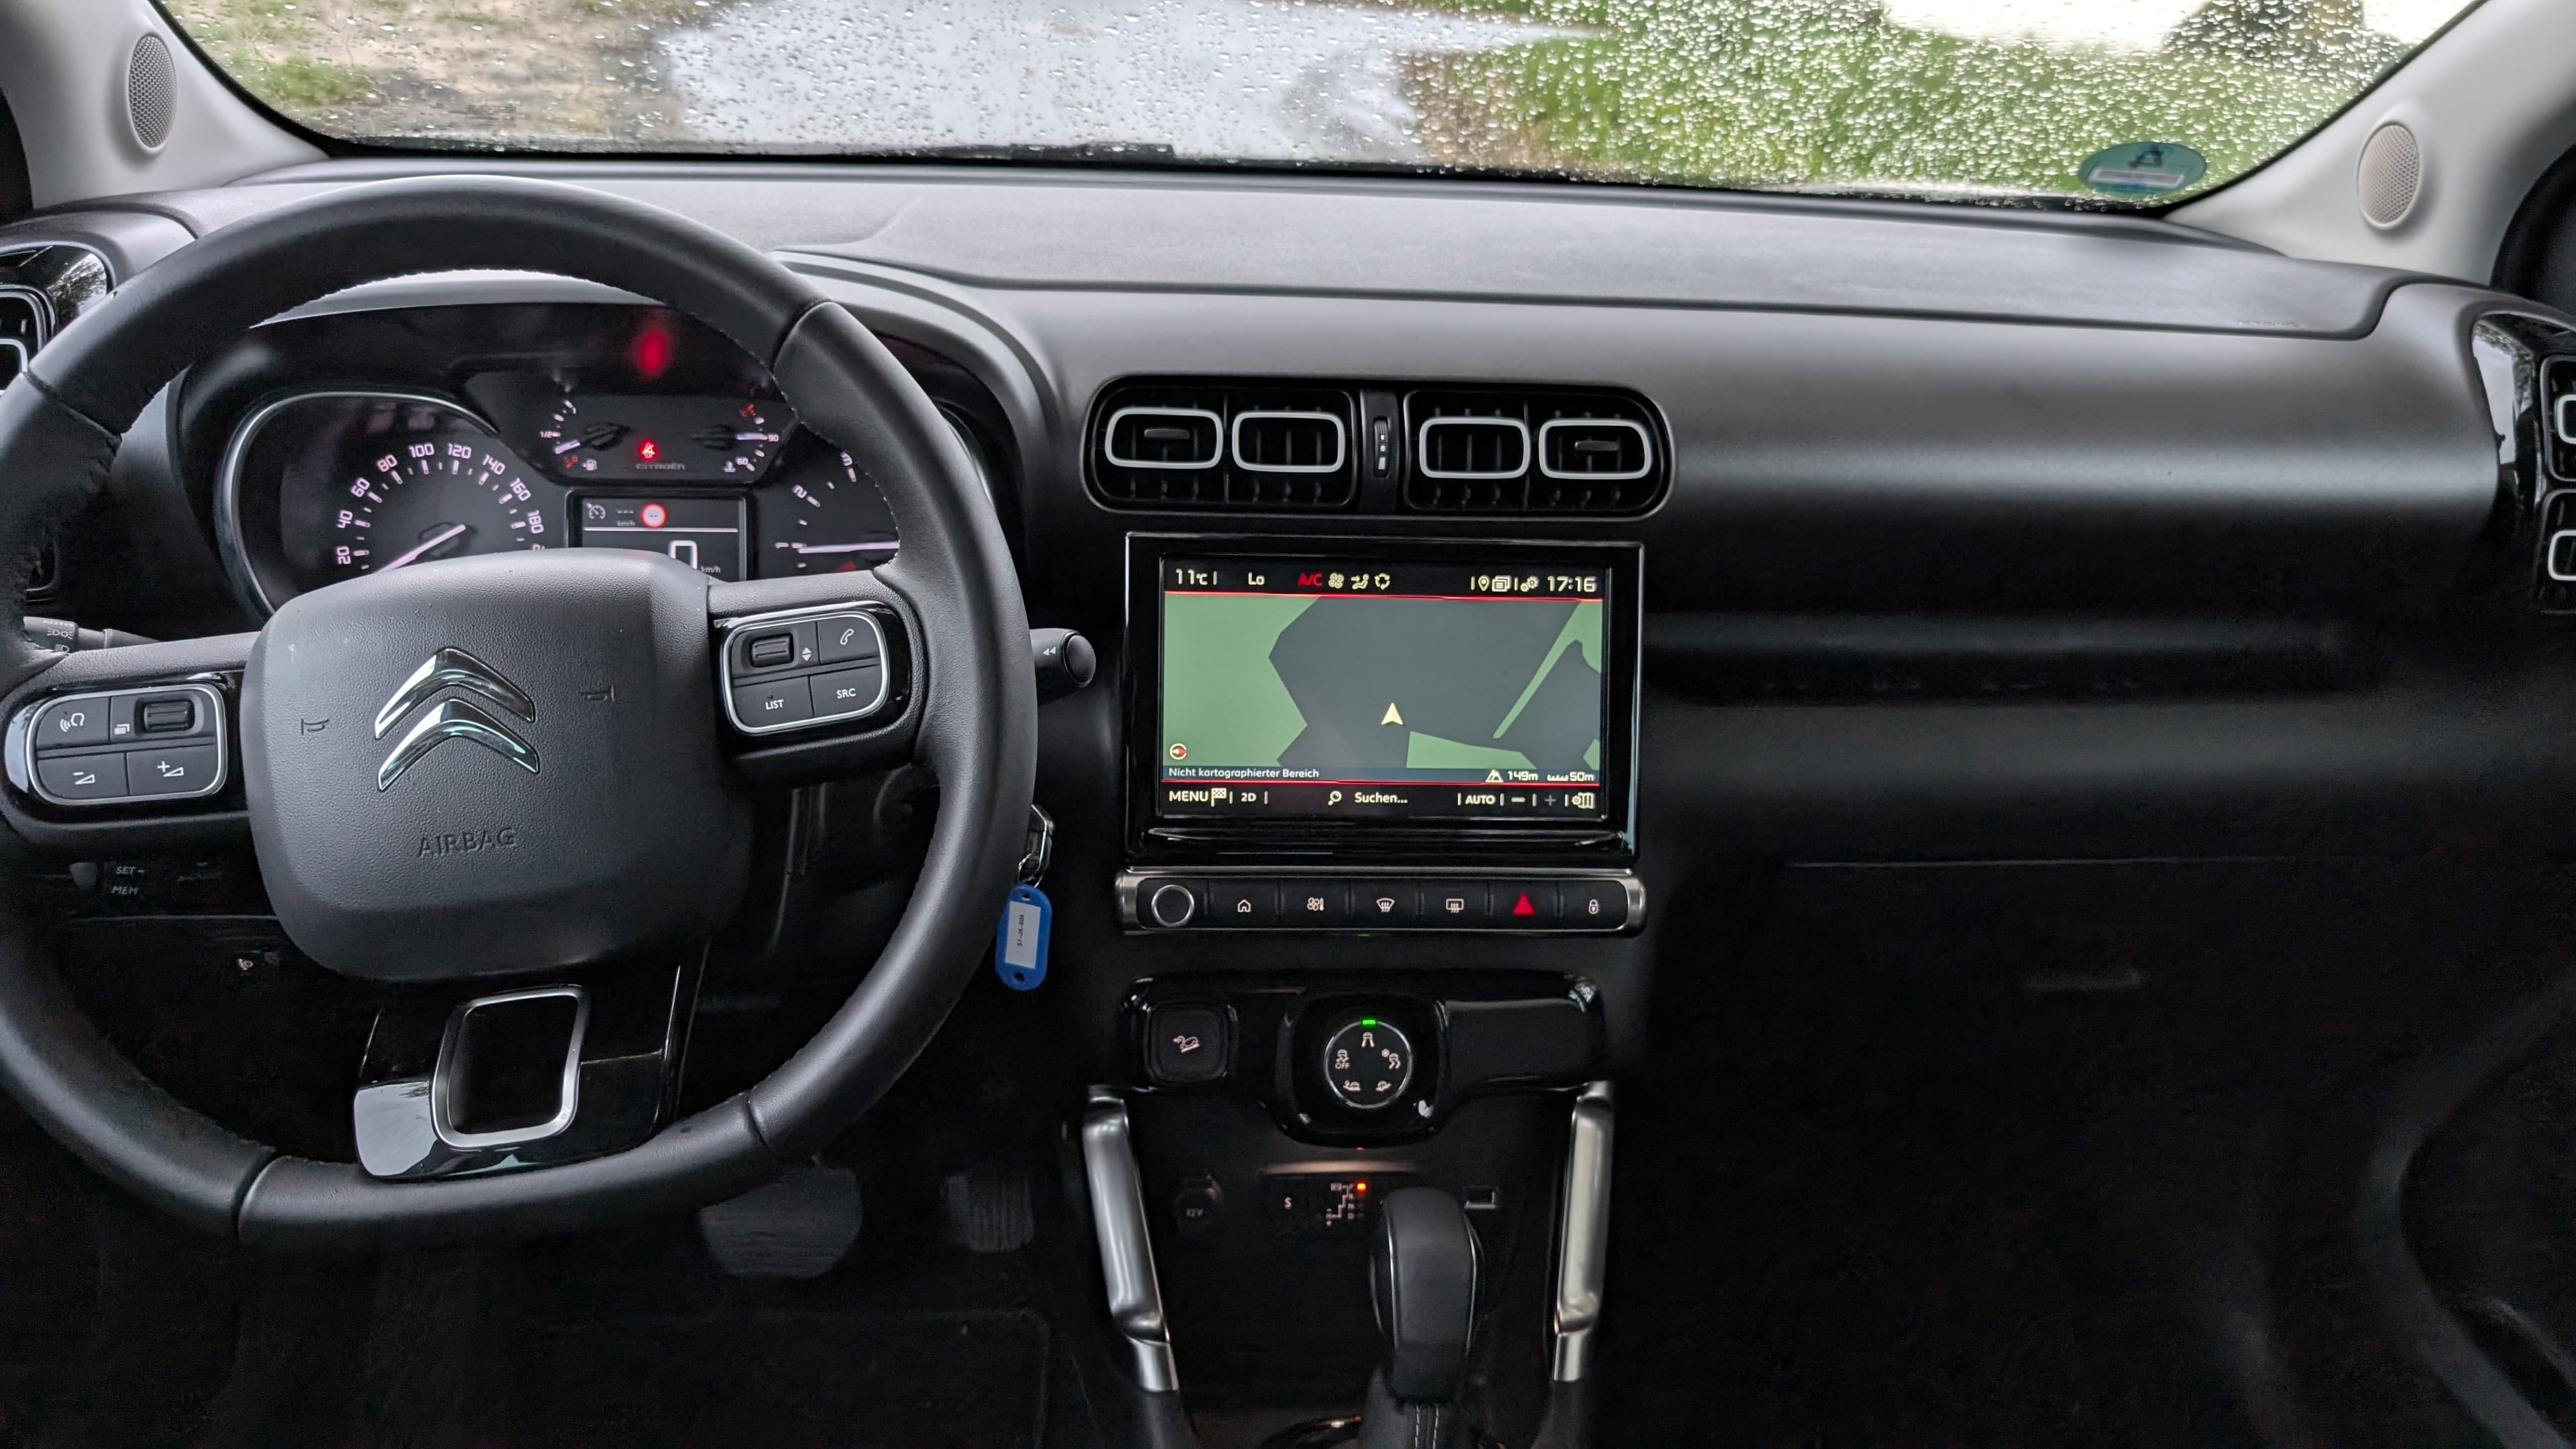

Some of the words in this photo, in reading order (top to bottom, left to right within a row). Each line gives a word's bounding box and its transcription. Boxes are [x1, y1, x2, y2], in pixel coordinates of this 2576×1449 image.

[540, 430, 553, 438] 1/2
[410, 443, 434, 458] 100
[448, 443, 471, 459] 120
[377, 454, 398, 472] 80
[483, 454, 506, 475] 140
[736, 457, 748, 465] 60
[350, 477, 370, 497] 60
[510, 477, 531, 501] 160
[792, 485, 807, 498] 2
[337, 510, 353, 528] 40
[528, 509, 544, 533] 180
[337, 546, 351, 565] 20
[1248, 572, 1265, 586] Lo
[1298, 573, 1323, 586] A/C
[1547, 576, 1597, 592] 17:16
[836, 688, 857, 699] SRC
[765, 699, 785, 710] LIST
[1169, 767, 1196, 778] Nicht
[1198, 768, 1280, 780] kartographierter
[1282, 769, 1319, 778] Bereich
[1507, 770, 1538, 781] 149m
[1569, 771, 1595, 781] 50m
[1169, 790, 1209, 802] MENU
[1241, 792, 1257, 802] 2D
[1354, 792, 1408, 804] Suchen...
[1465, 794, 1496, 804] AUTO
[419, 827, 515, 857] AIRBAG
[116, 866, 137, 875] SET
[112, 885, 139, 895] MEM
[1284, 1197, 1292, 1209] S
